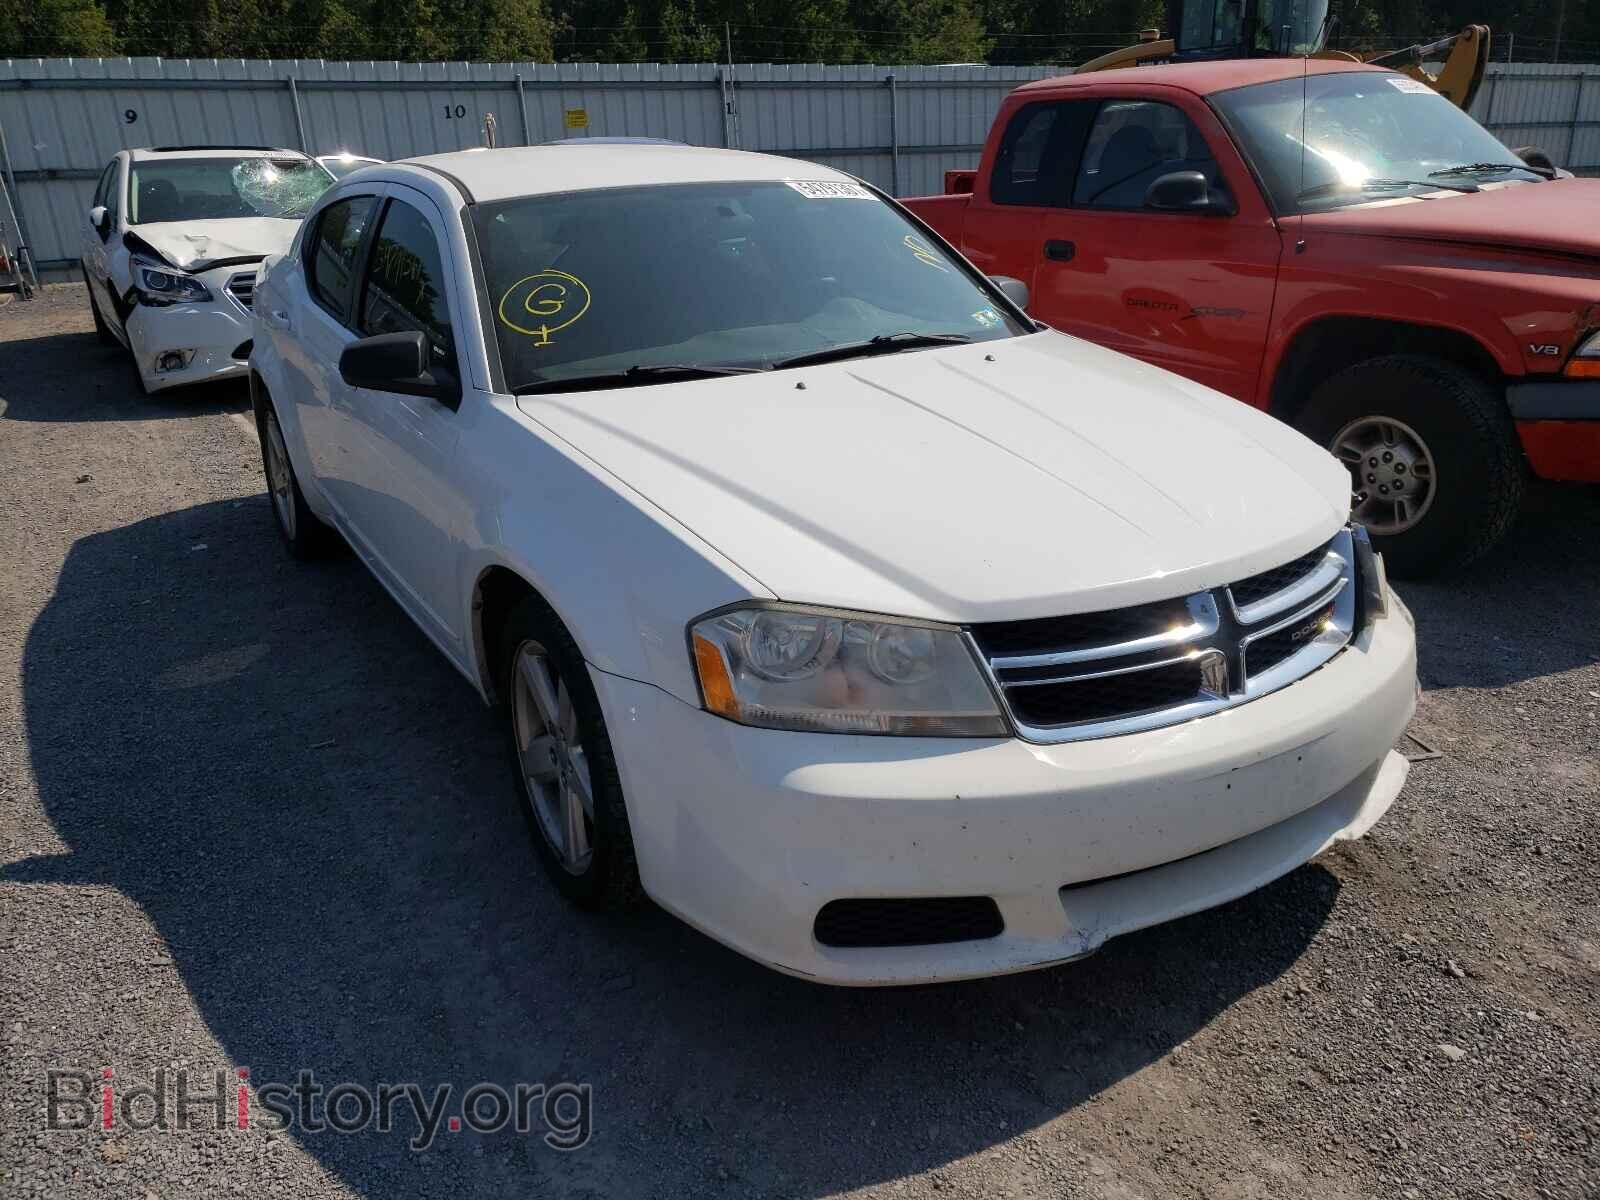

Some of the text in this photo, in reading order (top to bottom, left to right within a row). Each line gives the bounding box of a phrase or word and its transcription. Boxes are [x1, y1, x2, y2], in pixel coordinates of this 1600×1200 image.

[124, 108, 138, 124] 9
[444, 104, 466, 119] 10
[525, 283, 566, 315] G
[1529, 343, 1560, 355] V8
